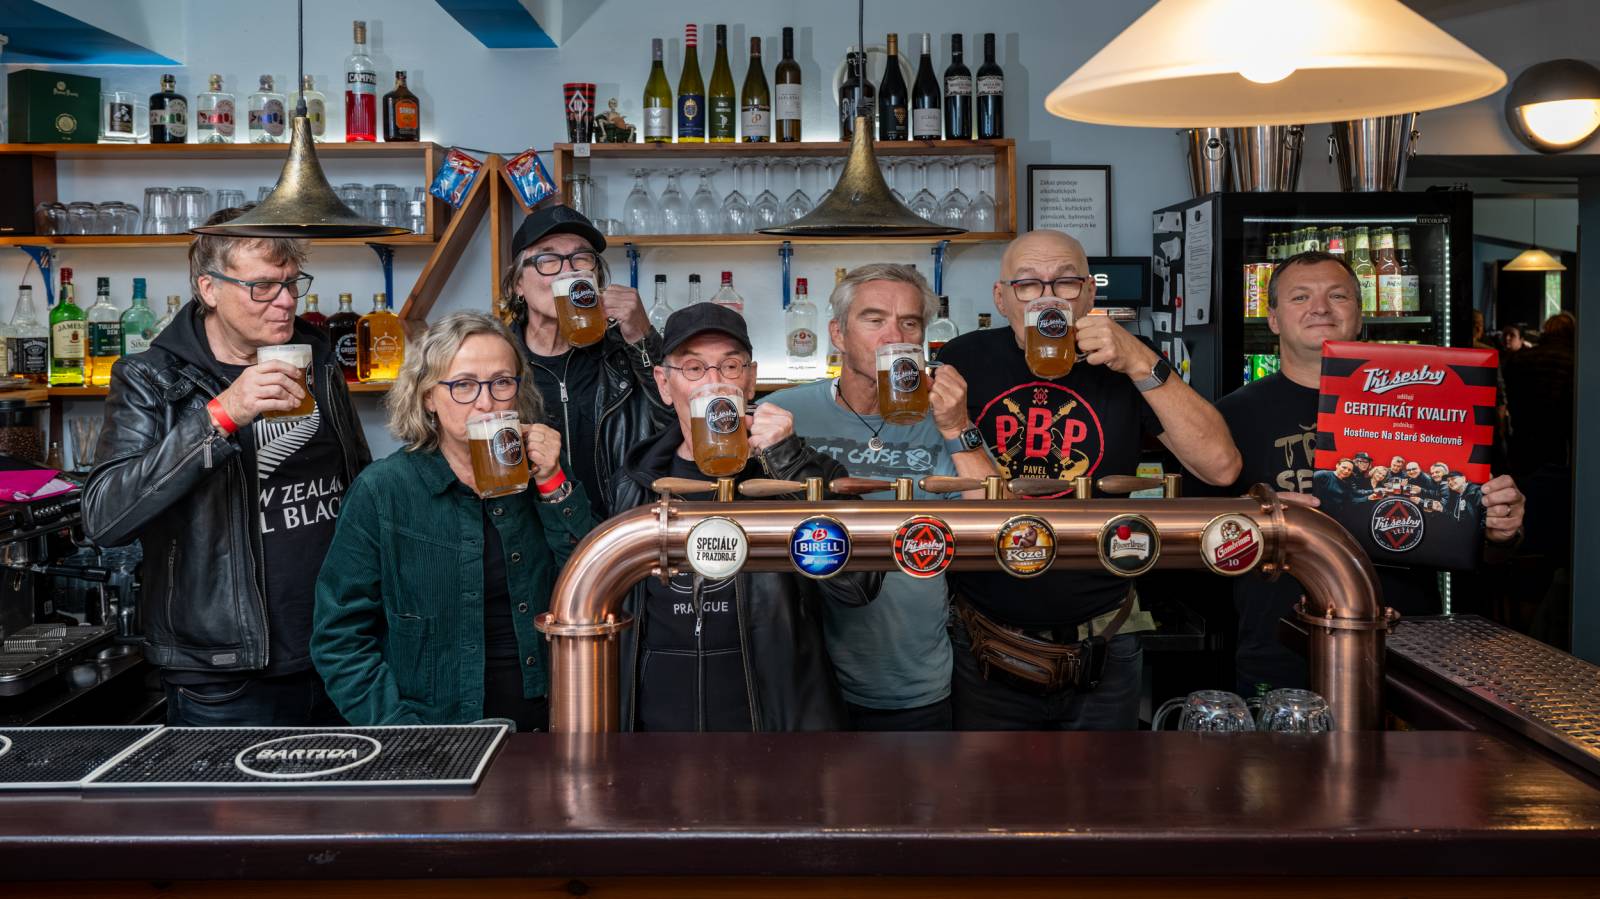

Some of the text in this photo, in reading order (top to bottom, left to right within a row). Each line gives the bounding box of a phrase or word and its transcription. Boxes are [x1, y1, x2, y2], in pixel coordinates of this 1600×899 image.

[1363, 365, 1446, 393] Tři sestry
[1344, 401, 1467, 423] CERTIFIKÁT KVALITY
[995, 407, 1088, 461] PBP
[1344, 427, 1463, 446] Hostinec Na Staré Sokolovně
[1023, 465, 1047, 475] PAVEL
[283, 496, 344, 530] BLAC
[696, 536, 738, 550] SPECIÁLY
[800, 542, 840, 552] BIRELL
[696, 551, 737, 561] Z PRAZDROJE
[1006, 548, 1047, 561] Kozel
[1228, 558, 1240, 567] 10
[673, 601, 729, 615] PRAGUE
[256, 748, 358, 760] BARTIDA
